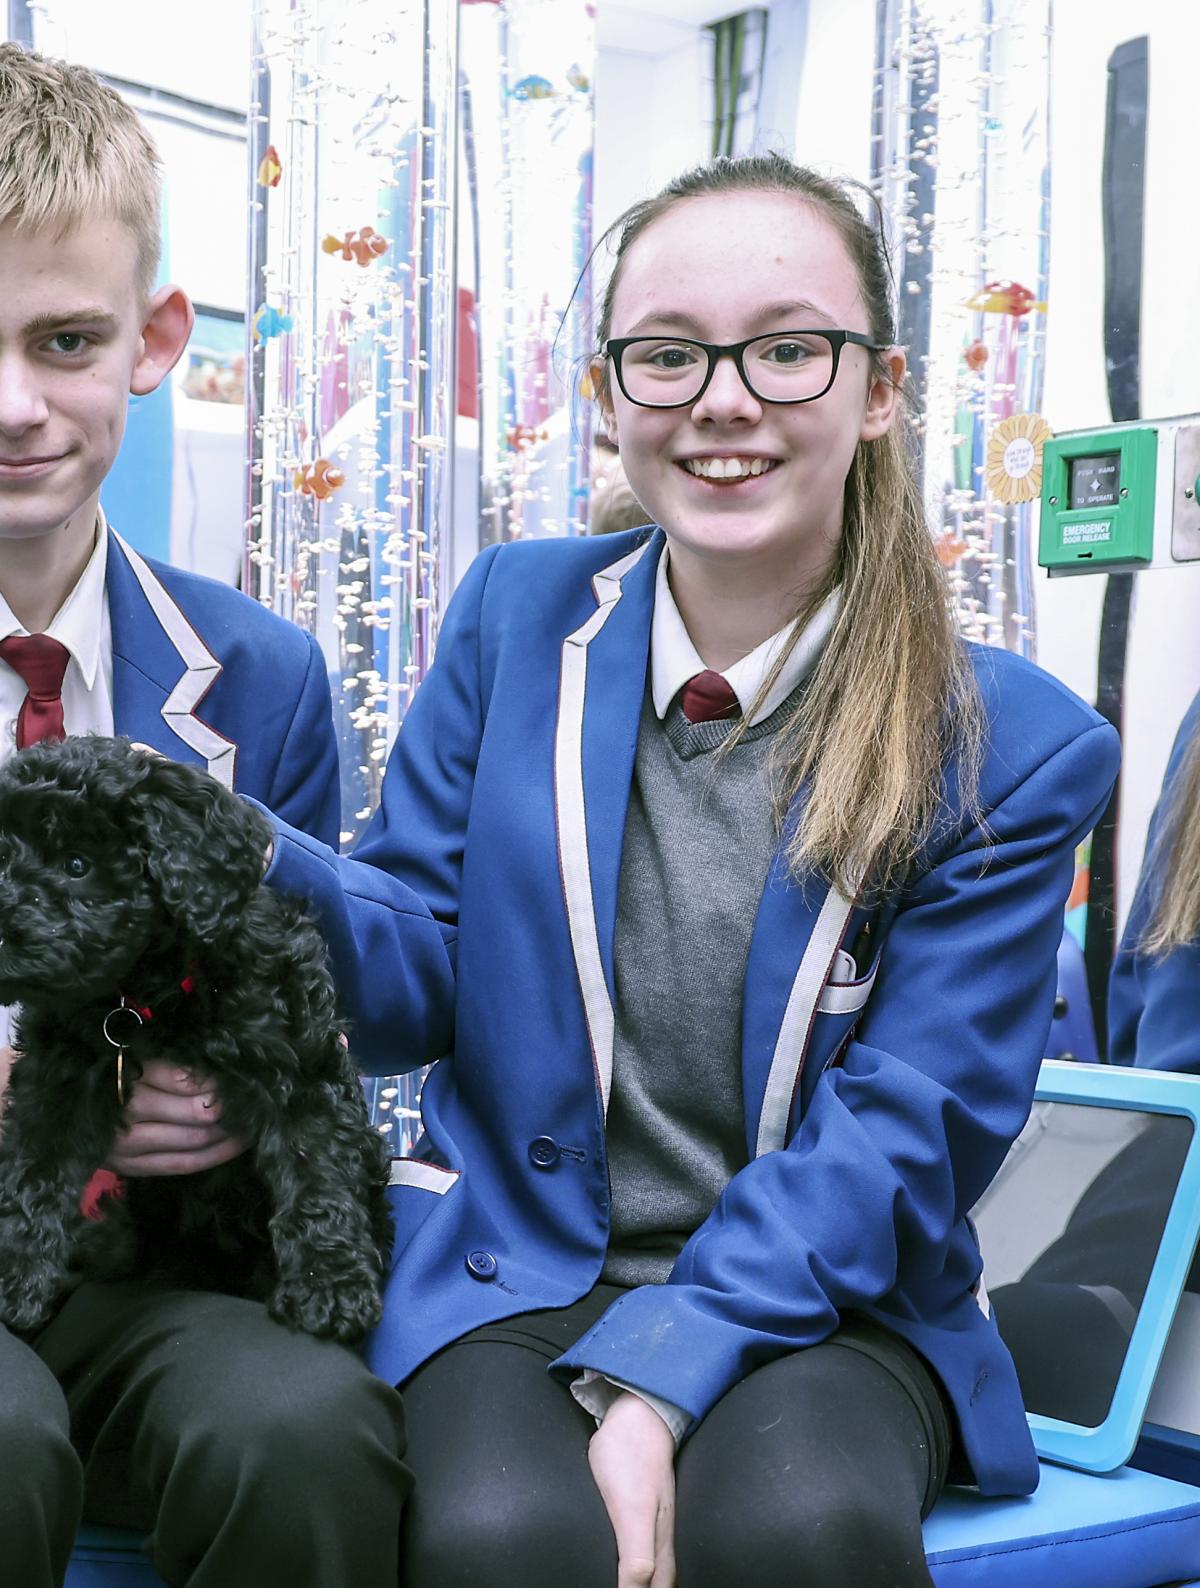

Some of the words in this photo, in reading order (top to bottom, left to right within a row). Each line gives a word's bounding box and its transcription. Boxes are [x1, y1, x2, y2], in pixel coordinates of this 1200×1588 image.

[1098, 466, 1115, 474] HARD
[1087, 494, 1113, 502] OPERATE
[1063, 522, 1111, 536] EMERGENCY
[1063, 535, 1081, 544] DOOR
[1082, 532, 1110, 542] RELEASE
